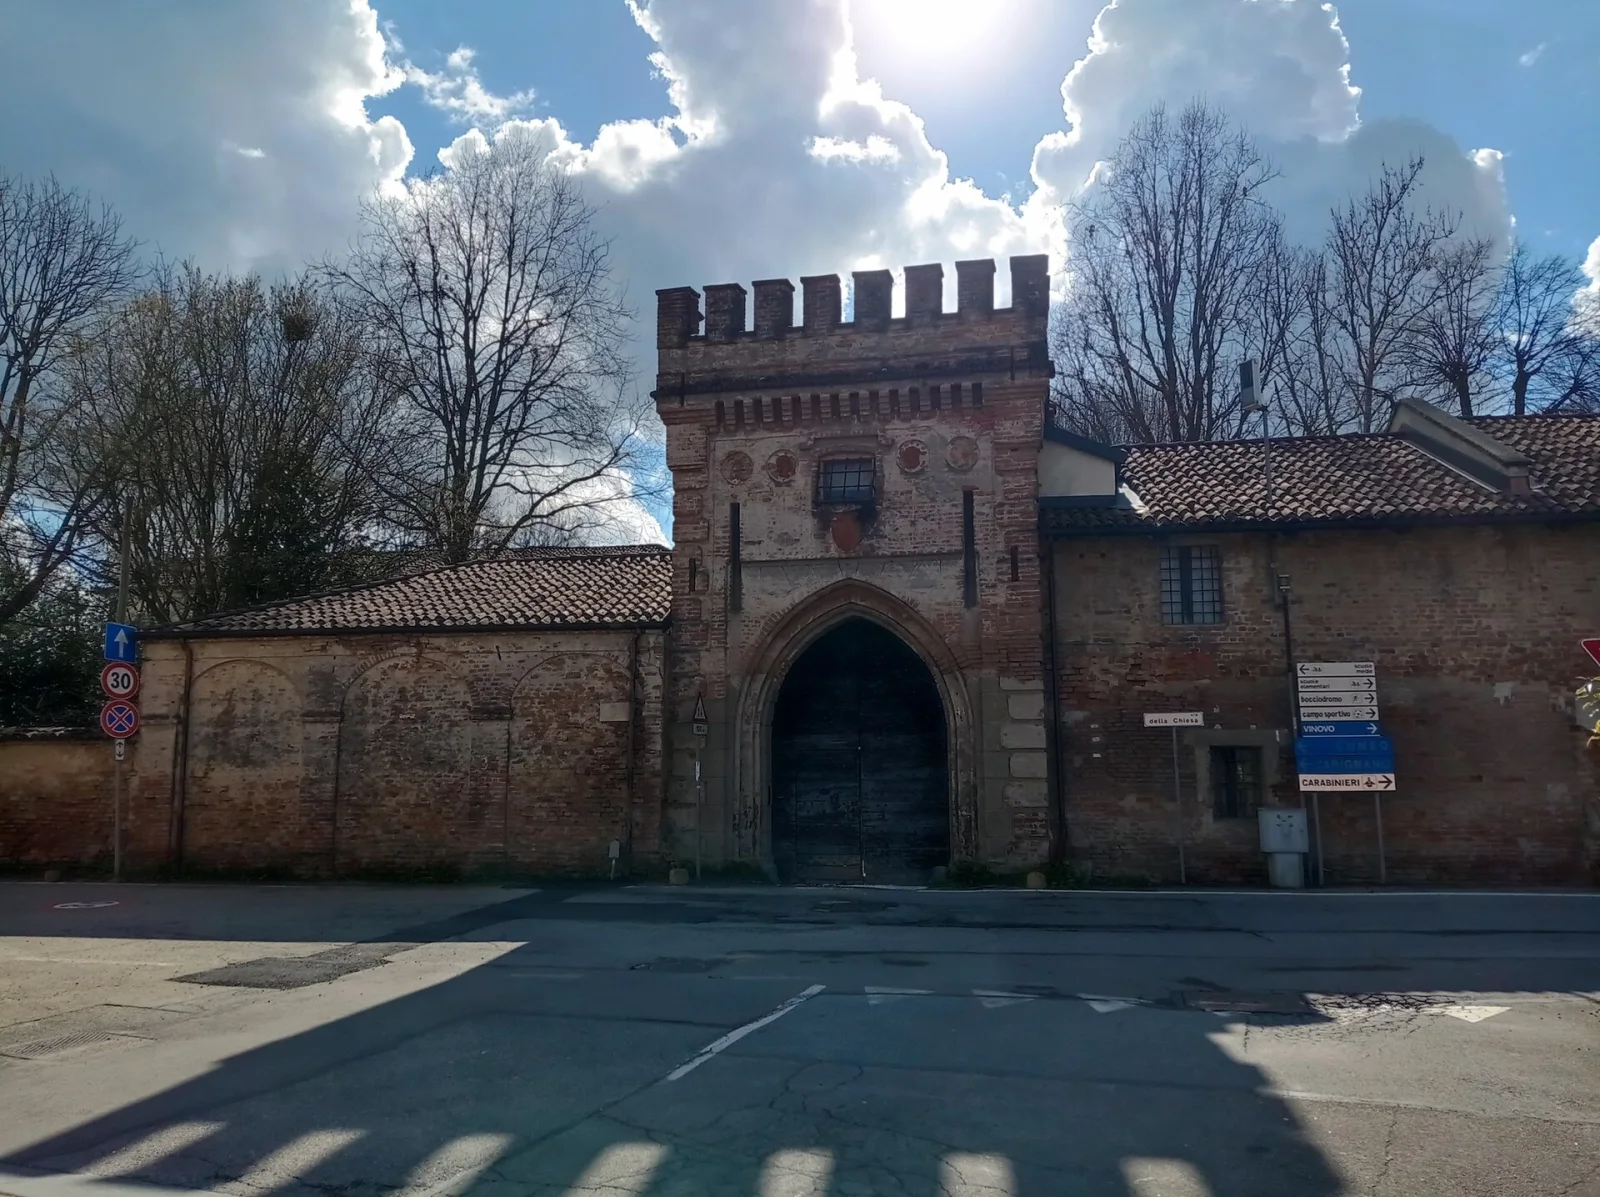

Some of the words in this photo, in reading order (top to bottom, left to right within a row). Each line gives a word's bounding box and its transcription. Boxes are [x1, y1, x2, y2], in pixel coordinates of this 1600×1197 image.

[110, 672, 131, 690] 30
[1303, 725, 1335, 733] VINOVO
[1302, 779, 1360, 787] CARABINIERI
